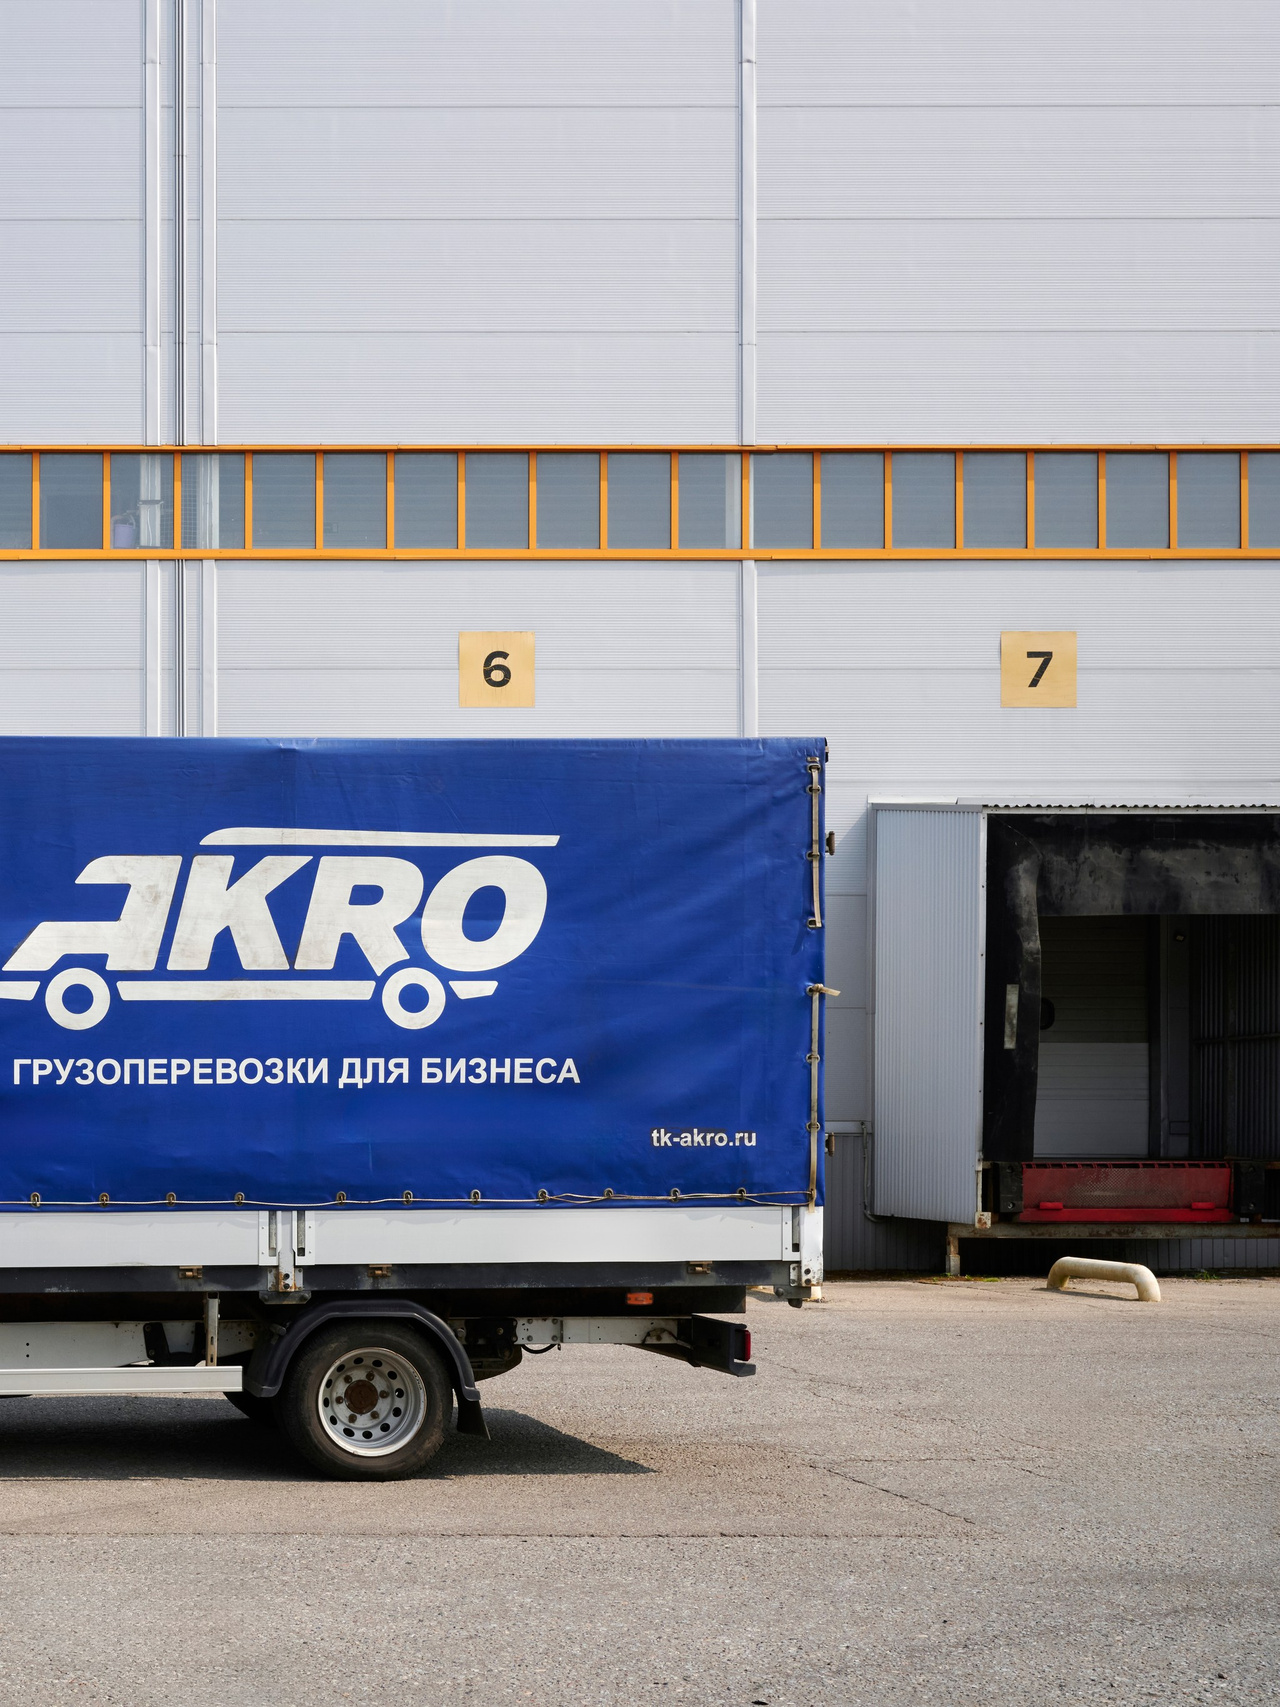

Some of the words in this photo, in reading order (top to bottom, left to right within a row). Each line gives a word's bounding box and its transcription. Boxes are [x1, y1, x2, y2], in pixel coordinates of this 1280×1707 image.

[483, 650, 512, 688] 6
[1026, 651, 1053, 688] 7
[1, 854, 548, 977] AKRO
[13, 1057, 329, 1085] ГРУЗОПЕРЕВОЗКИ
[338, 1057, 409, 1089] ДЛЯ
[421, 1057, 581, 1085] БИЗНЕСА
[651, 1128, 757, 1147] tk-akro.ru
